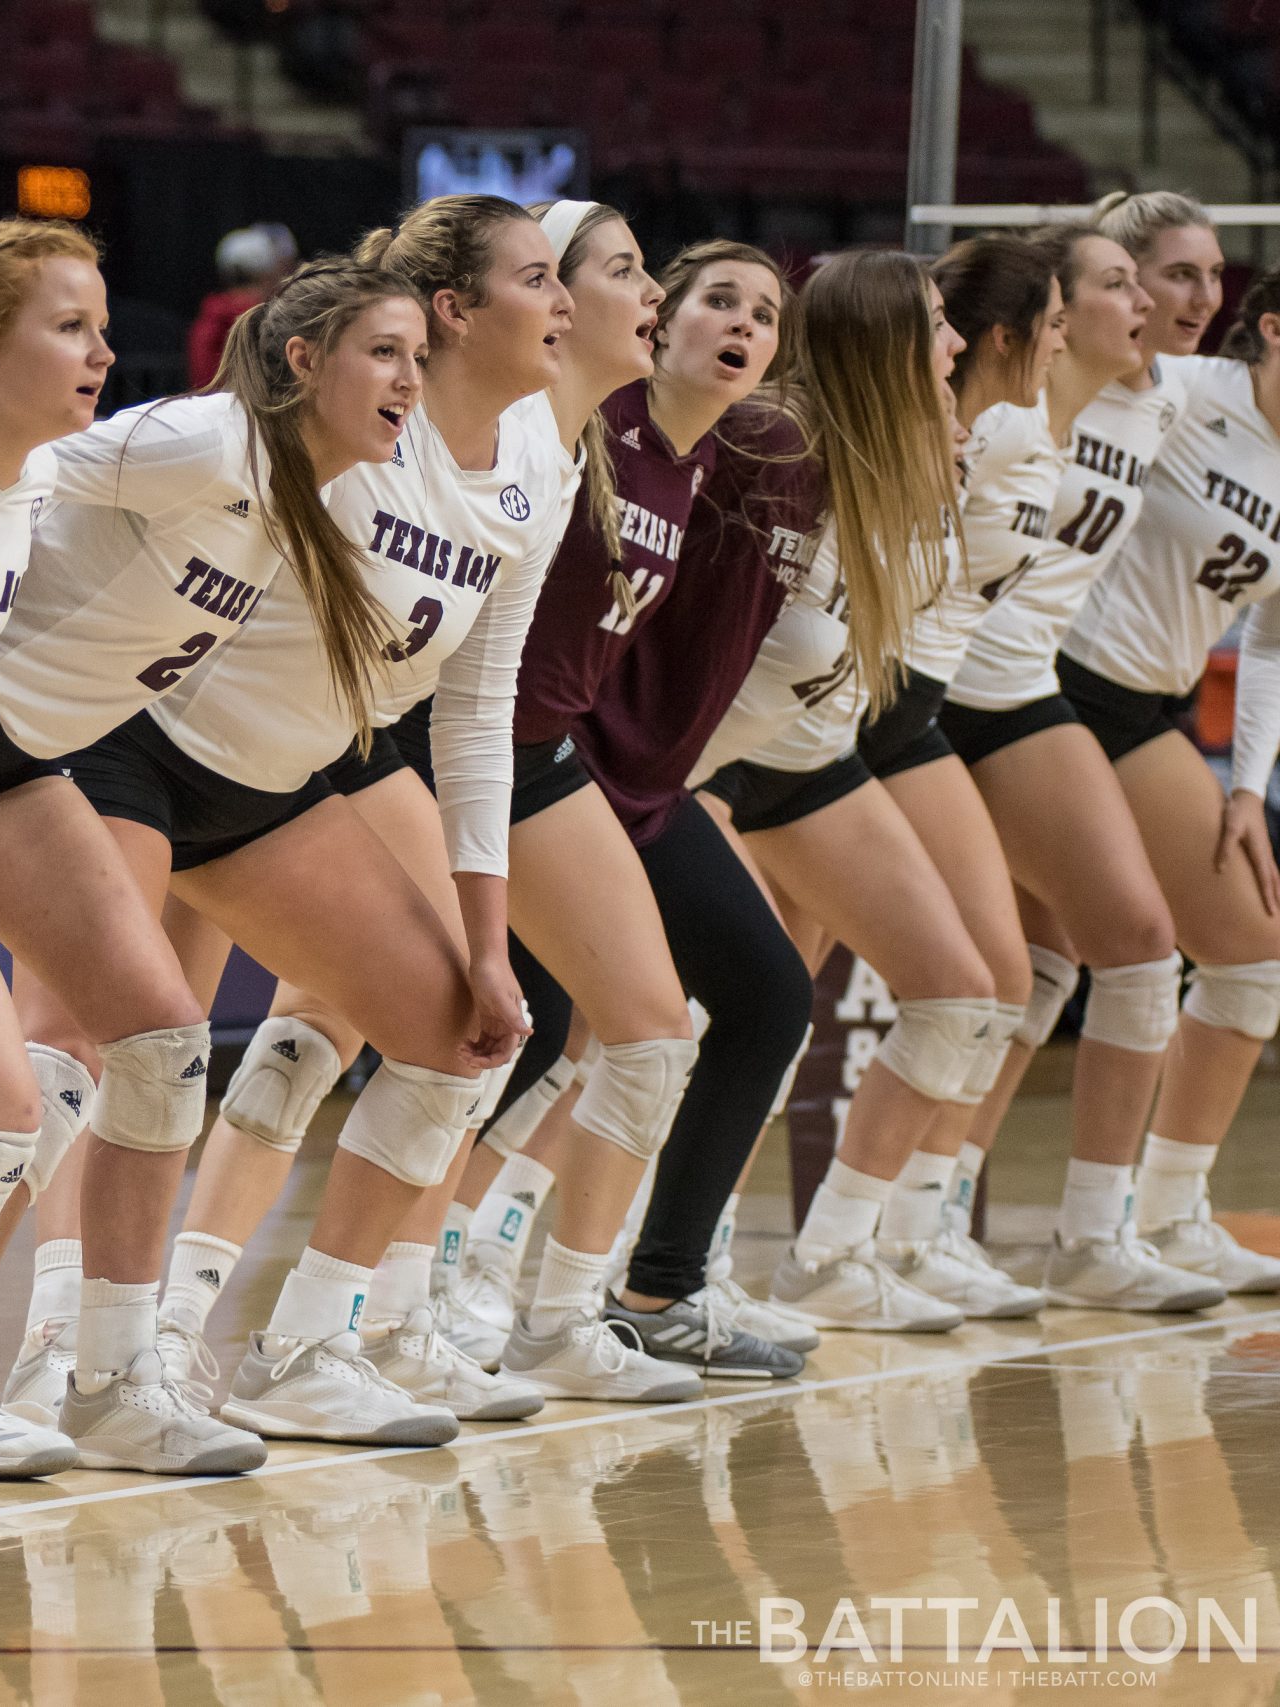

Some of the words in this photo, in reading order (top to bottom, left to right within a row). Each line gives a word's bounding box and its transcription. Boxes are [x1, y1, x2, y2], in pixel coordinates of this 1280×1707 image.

[1056, 488, 1125, 556] 10
[1206, 468, 1272, 532] TEXAS
[369, 509, 453, 581] TEXAS
[451, 545, 502, 594] A&M
[1196, 533, 1271, 603] 22
[173, 555, 257, 622] TEXAS
[135, 631, 219, 693] 2
[380, 595, 445, 663] 3
